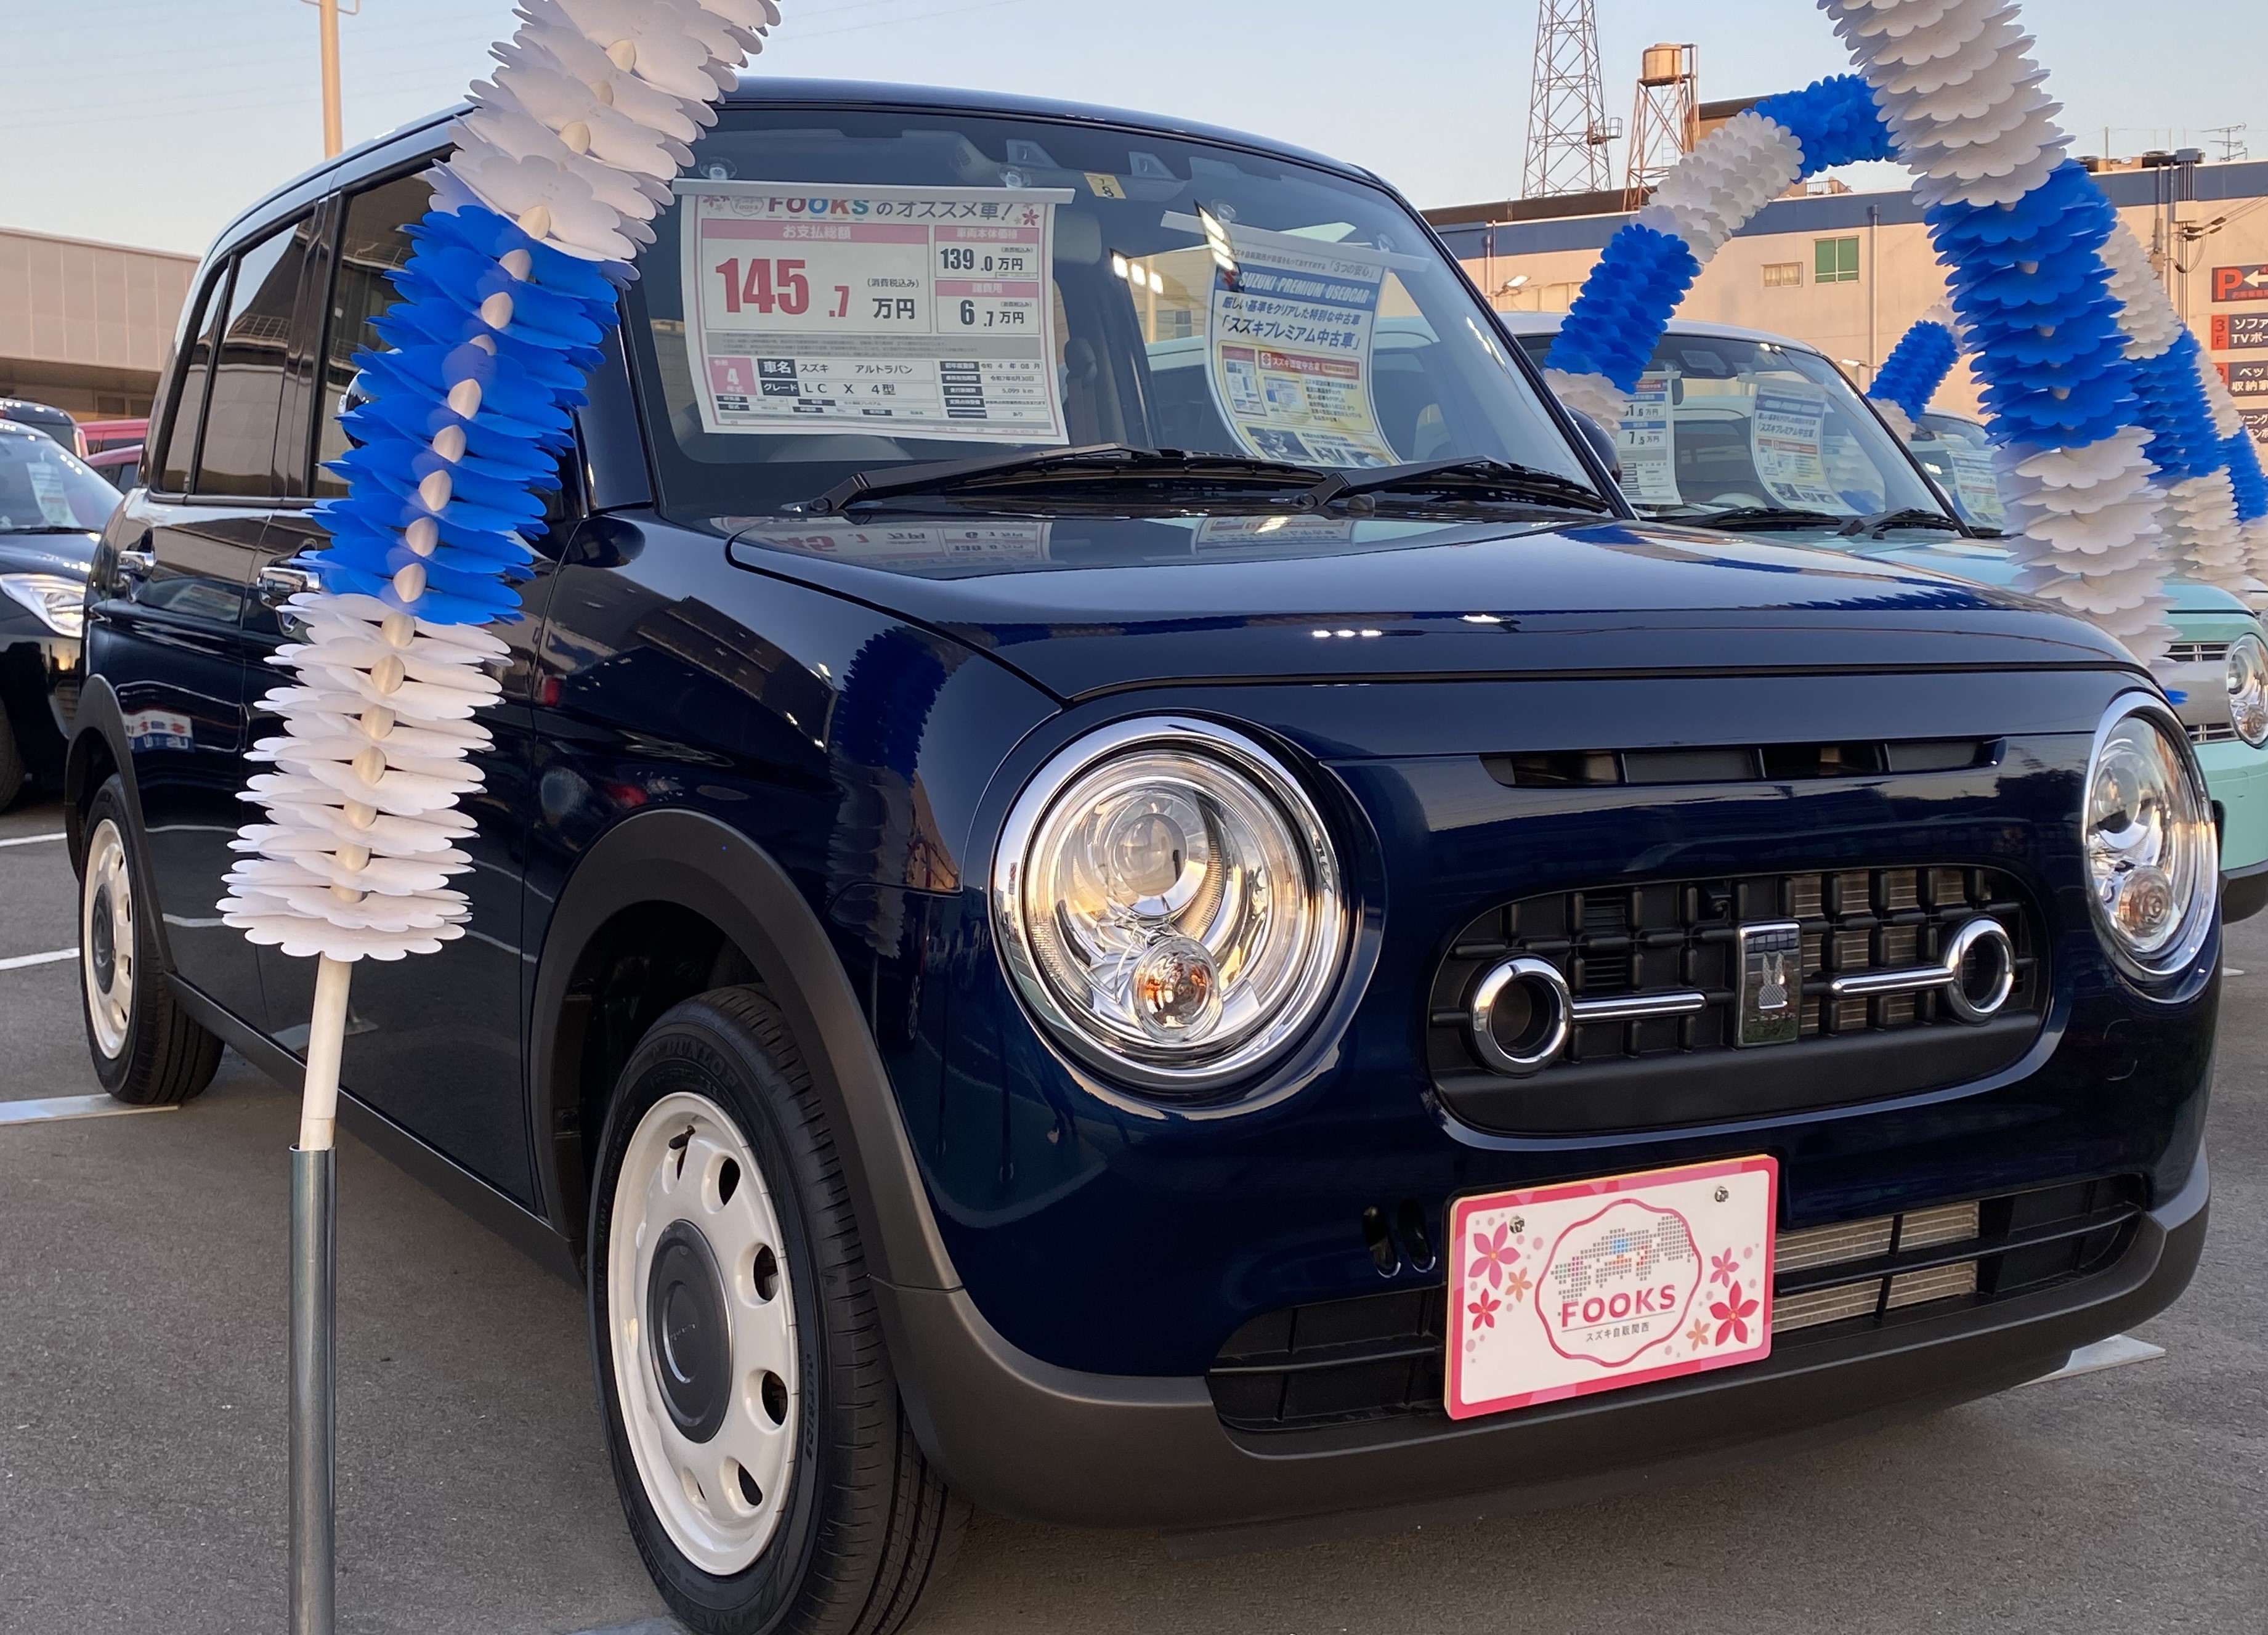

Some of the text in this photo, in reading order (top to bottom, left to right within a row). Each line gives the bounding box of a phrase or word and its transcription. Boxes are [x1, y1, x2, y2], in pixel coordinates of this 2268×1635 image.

[768, 197, 870, 215] FOOKS
[783, 224, 852, 240] お支払総額
[940, 248, 974, 270] 139
[997, 258, 1023, 271] 万円
[715, 258, 915, 320] 145 .7 万円
[1238, 271, 1278, 291] SUZUKI
[1277, 278, 1326, 298] PREMIUM
[2217, 268, 2243, 299] P
[960, 299, 975, 326] 6
[998, 310, 1024, 324] 万円
[763, 360, 792, 375] 車名
[800, 363, 830, 373] スズキ
[2239, 365, 2268, 377] ベッ
[763, 383, 798, 392] グレード
[1561, 1284, 1676, 1328] FOOKS
[1586, 1321, 1650, 1342] スズキ自販関西
